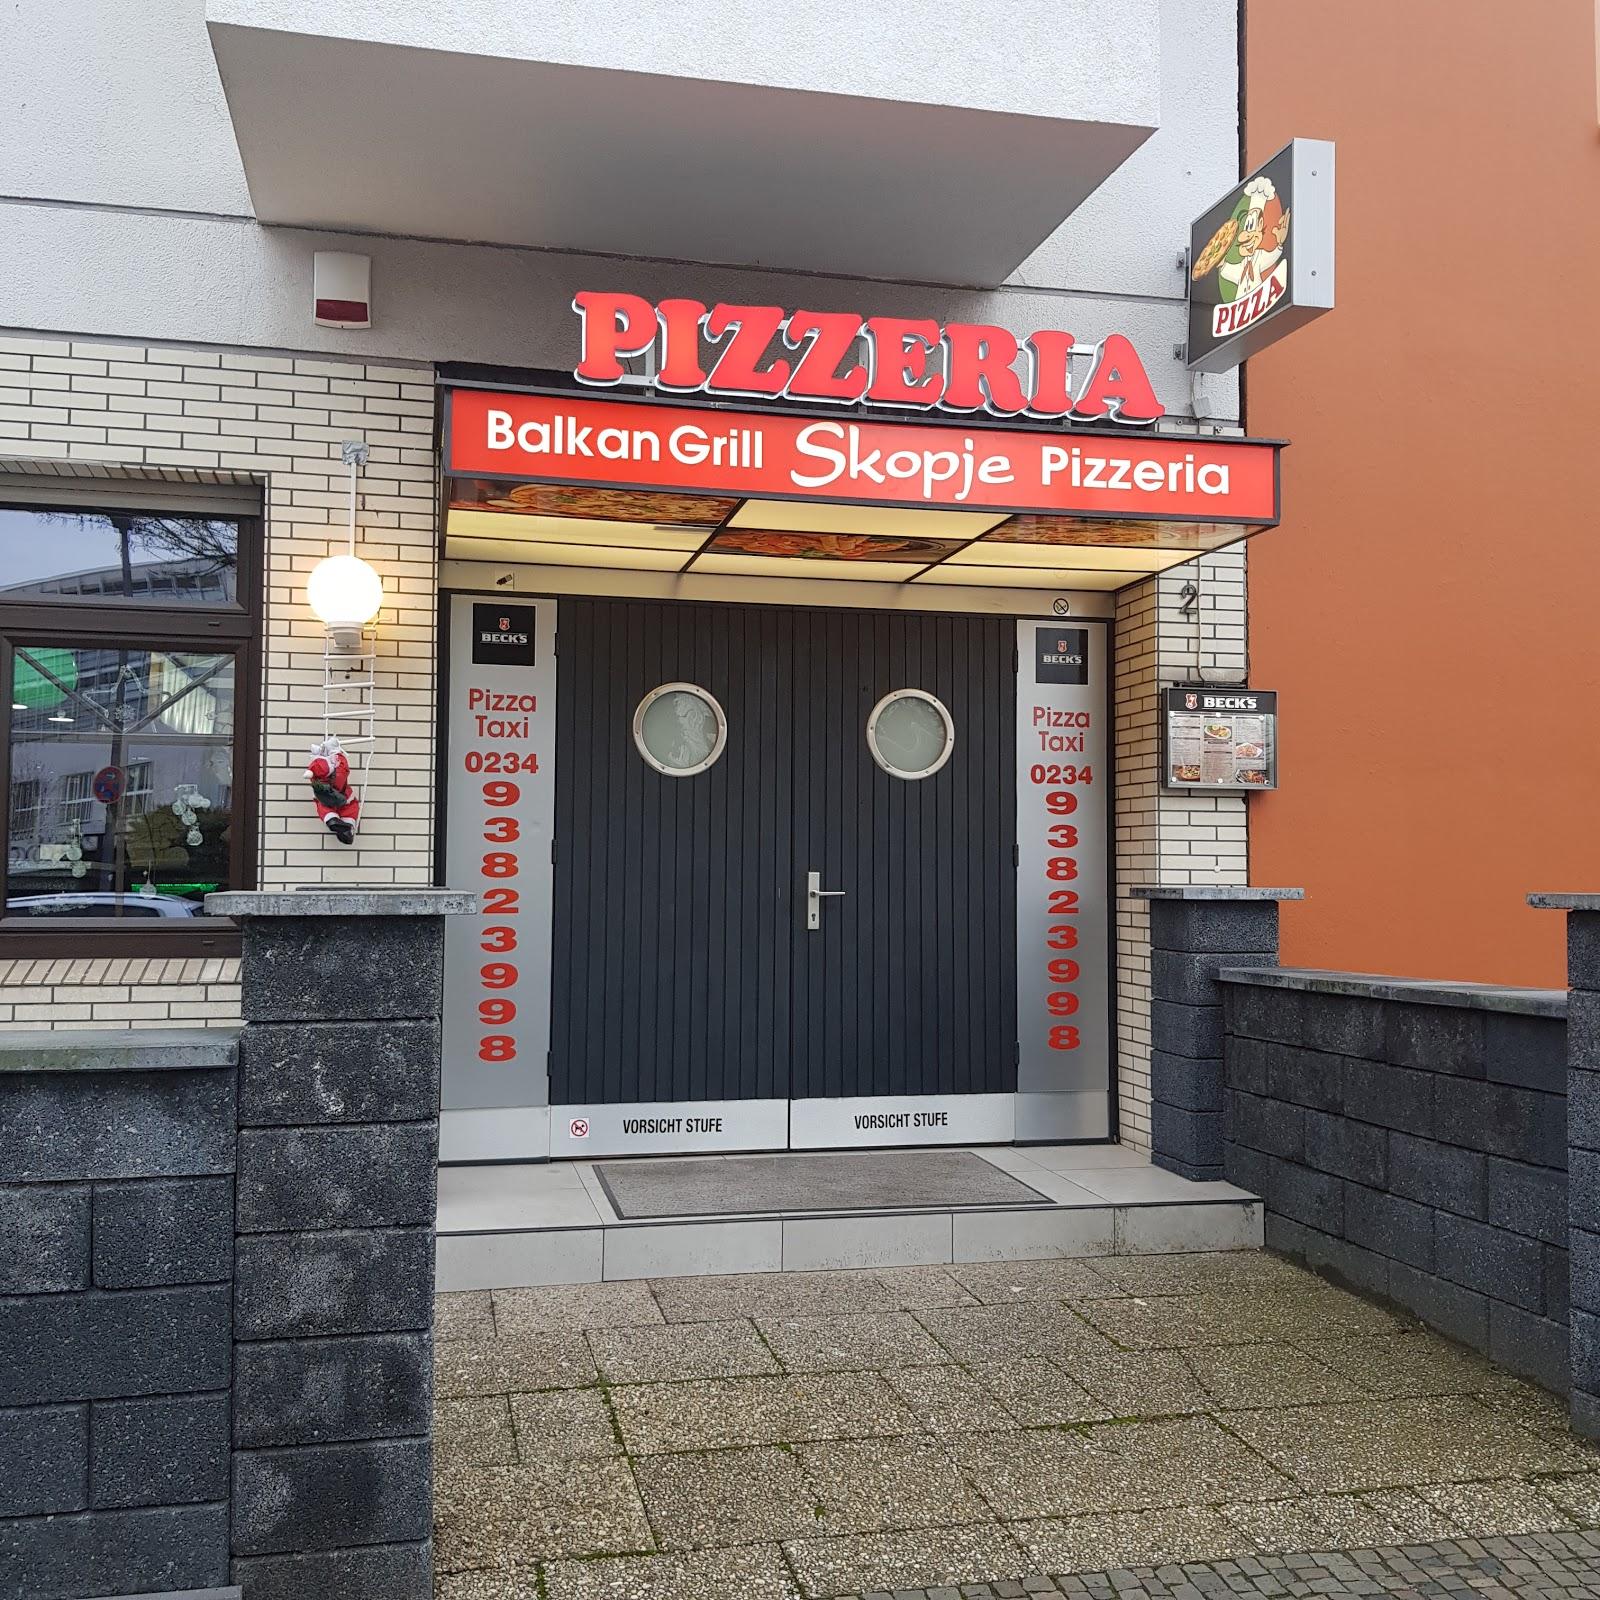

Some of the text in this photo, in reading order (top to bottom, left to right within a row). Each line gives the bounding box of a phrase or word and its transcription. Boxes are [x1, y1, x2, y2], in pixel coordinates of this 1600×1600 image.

[1215, 275, 1284, 335] PIZZA
[572, 291, 1165, 421] PIZZERIA
[487, 409, 1229, 503] Balkan Grill Skopje Pizzeria
[1179, 585, 1198, 615] 2
[481, 633, 528, 644] BECK'S
[1043, 655, 1083, 664] BECK'S
[469, 688, 537, 712] Pizza
[1203, 696, 1257, 709] BECK'S
[475, 715, 529, 738] Taxi
[1033, 706, 1090, 728] Pizza
[1038, 731, 1084, 752] Taxi
[465, 751, 539, 774] 0234
[1030, 764, 1093, 785] 0234
[623, 1118, 723, 1134] VORSICHT STUFE
[855, 1112, 948, 1130] VORSICHT STUFE
